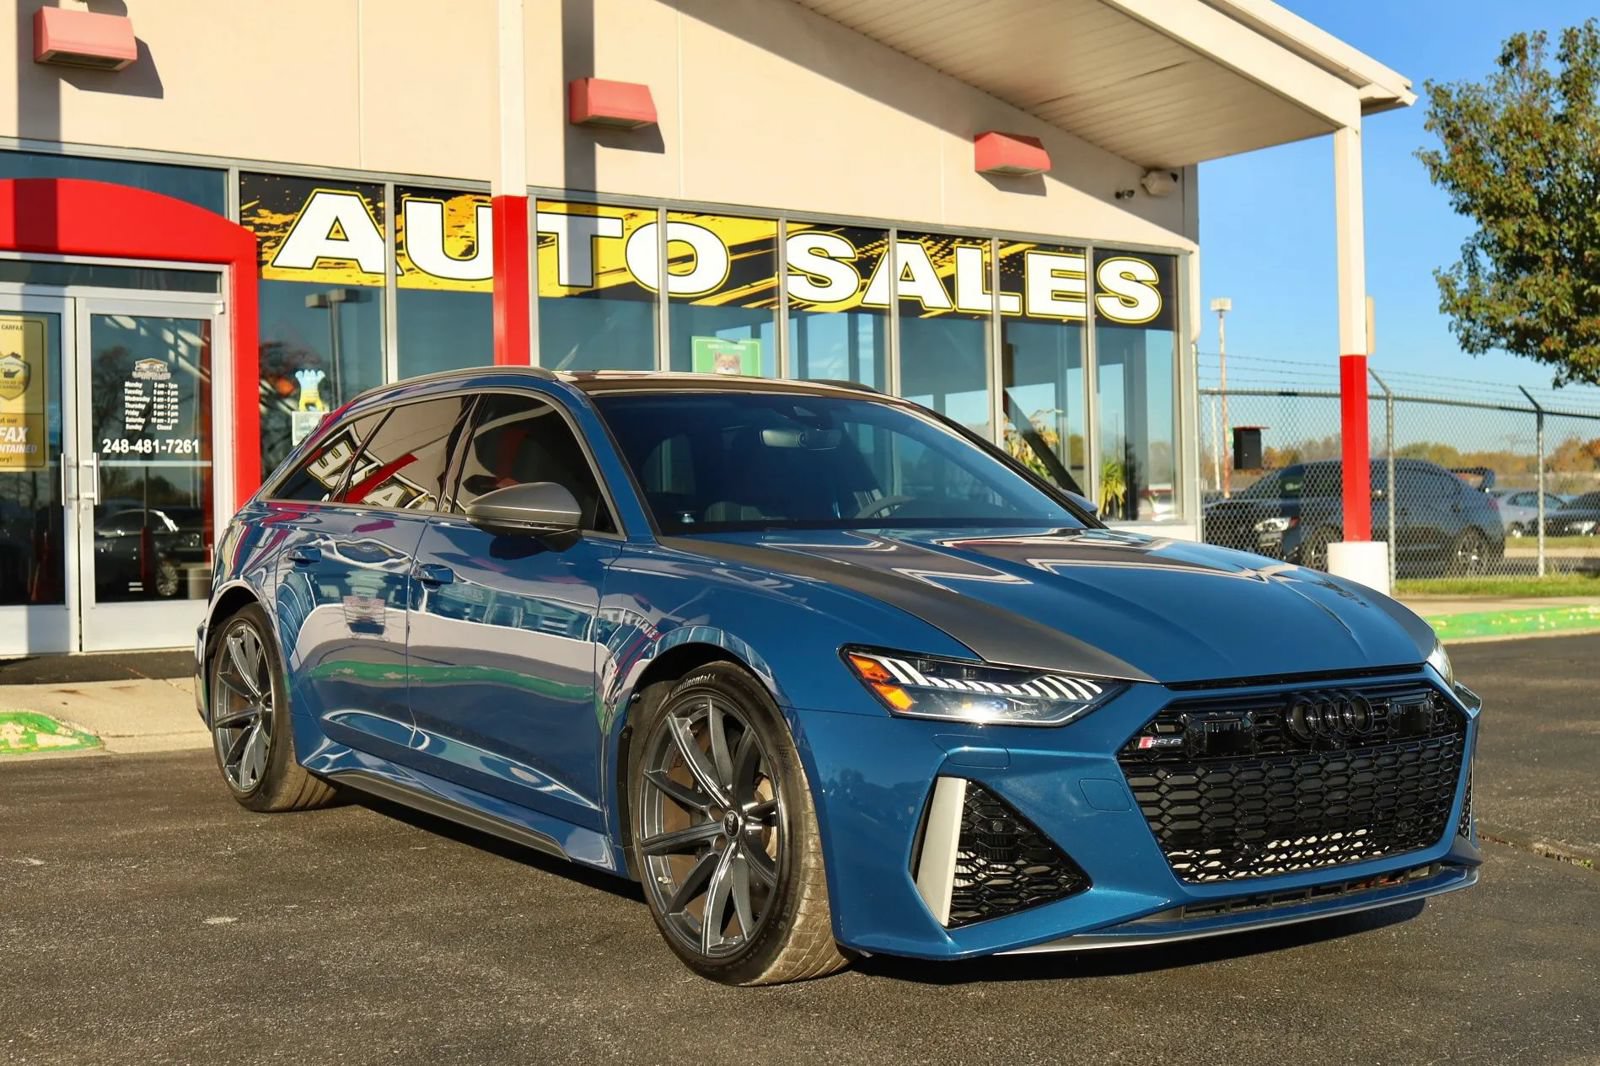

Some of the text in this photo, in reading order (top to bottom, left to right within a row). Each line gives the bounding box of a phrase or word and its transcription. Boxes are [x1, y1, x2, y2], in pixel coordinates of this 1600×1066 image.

[270, 187, 1163, 324] AUTO SALES
[102, 438, 200, 454] 248-481-7261
